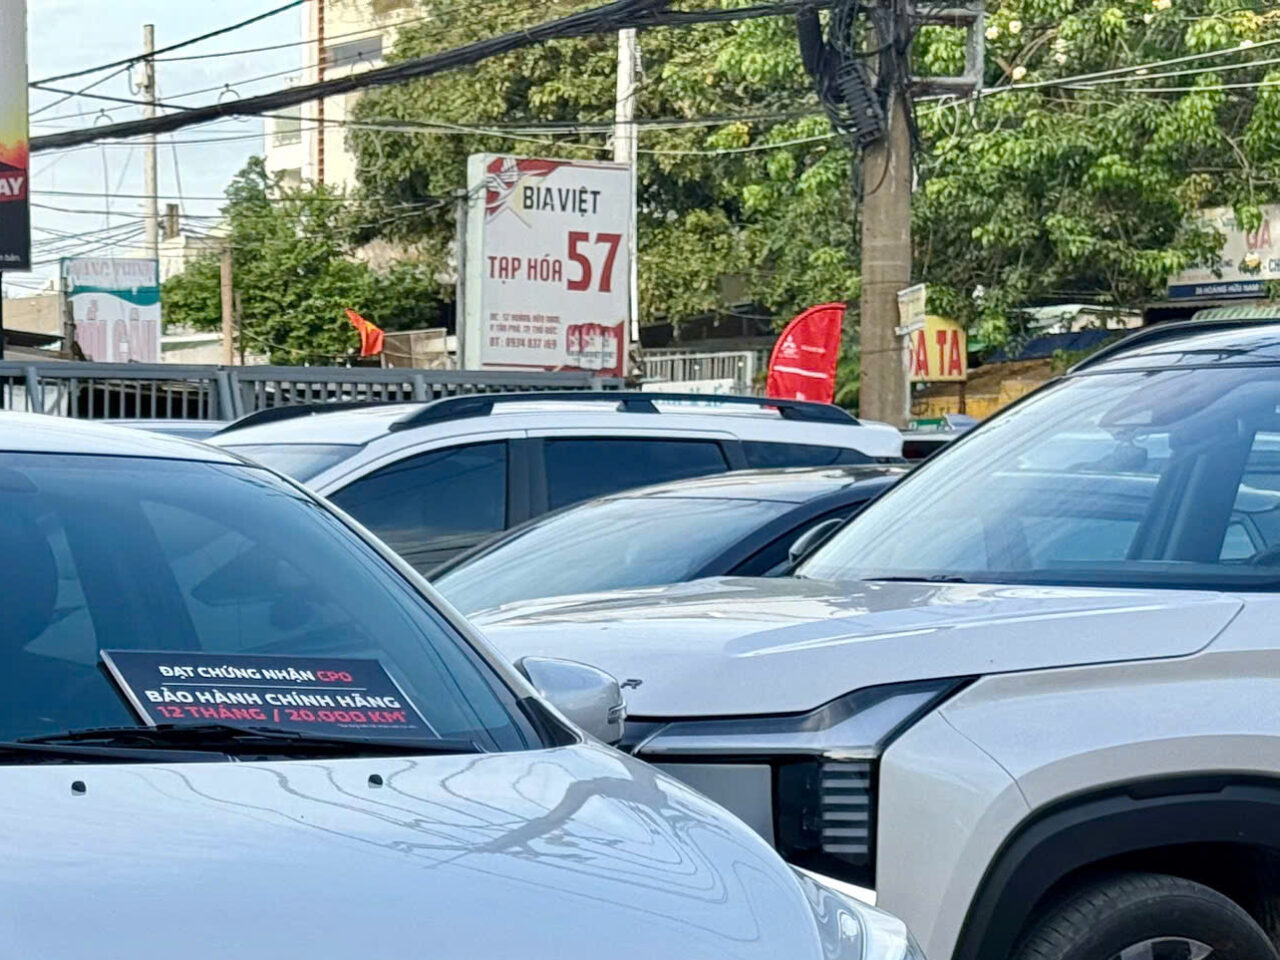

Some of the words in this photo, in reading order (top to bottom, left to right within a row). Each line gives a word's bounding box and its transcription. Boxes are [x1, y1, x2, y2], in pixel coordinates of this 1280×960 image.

[523, 186, 555, 211] BIA
[558, 186, 600, 217] VIỆT
[488, 256, 521, 285] TẠP
[527, 254, 562, 282] HÓA
[567, 231, 622, 292] 57
[936, 330, 962, 376] TA
[158, 666, 194, 680] ĐẠT
[200, 665, 261, 681] CHỨNG
[264, 667, 315, 682] NHẬN
[316, 669, 353, 683] CPO
[145, 687, 194, 704] BẢO
[197, 688, 262, 705] HÀNH
[265, 691, 335, 707] CHÍNH
[336, 693, 401, 709] HÃNG
[157, 705, 184, 719] 12
[188, 704, 266, 720] THÁNG
[285, 709, 367, 724] 20.000
